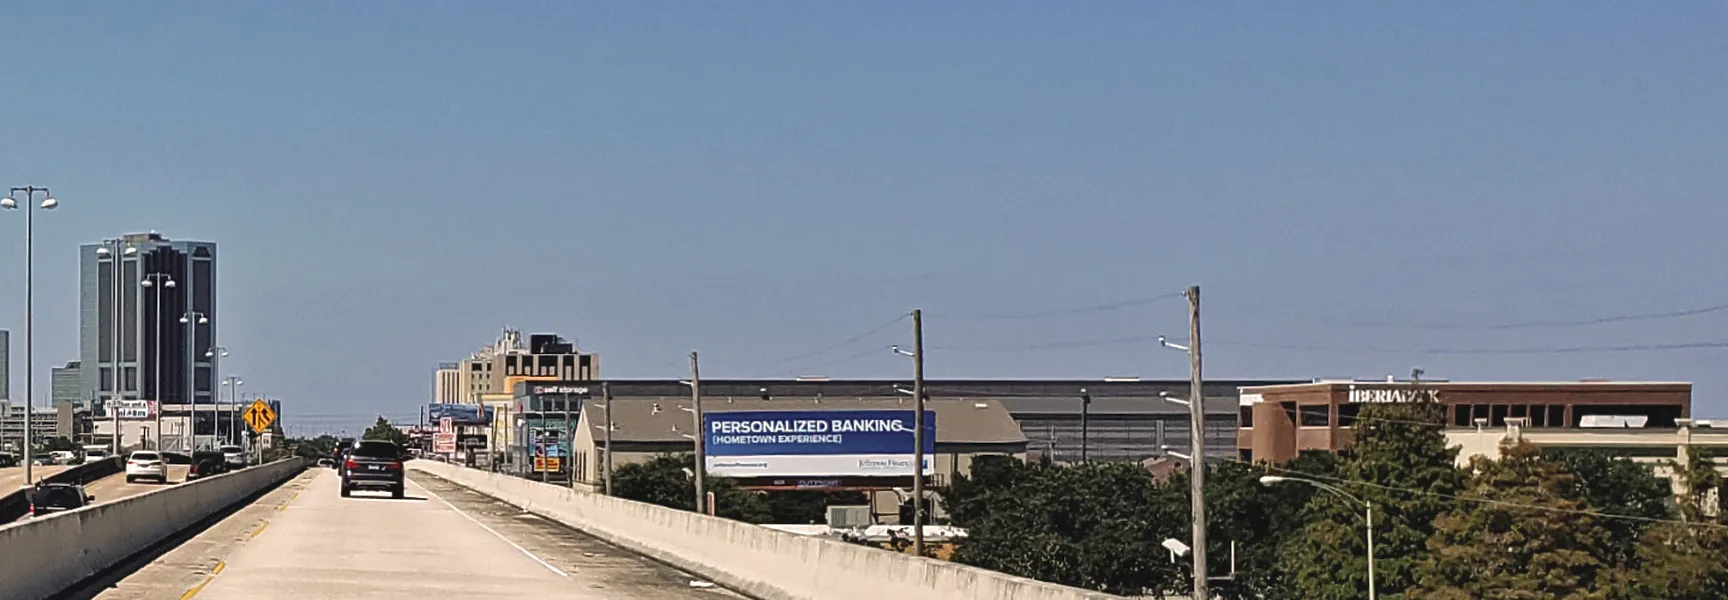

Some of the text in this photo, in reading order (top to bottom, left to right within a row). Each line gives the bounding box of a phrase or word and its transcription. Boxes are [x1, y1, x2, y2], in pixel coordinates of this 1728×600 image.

[711, 420, 903, 433] PERSONALIZED BANKING
[712, 434, 842, 445] (HOMETOWN EXPERIENCE)
